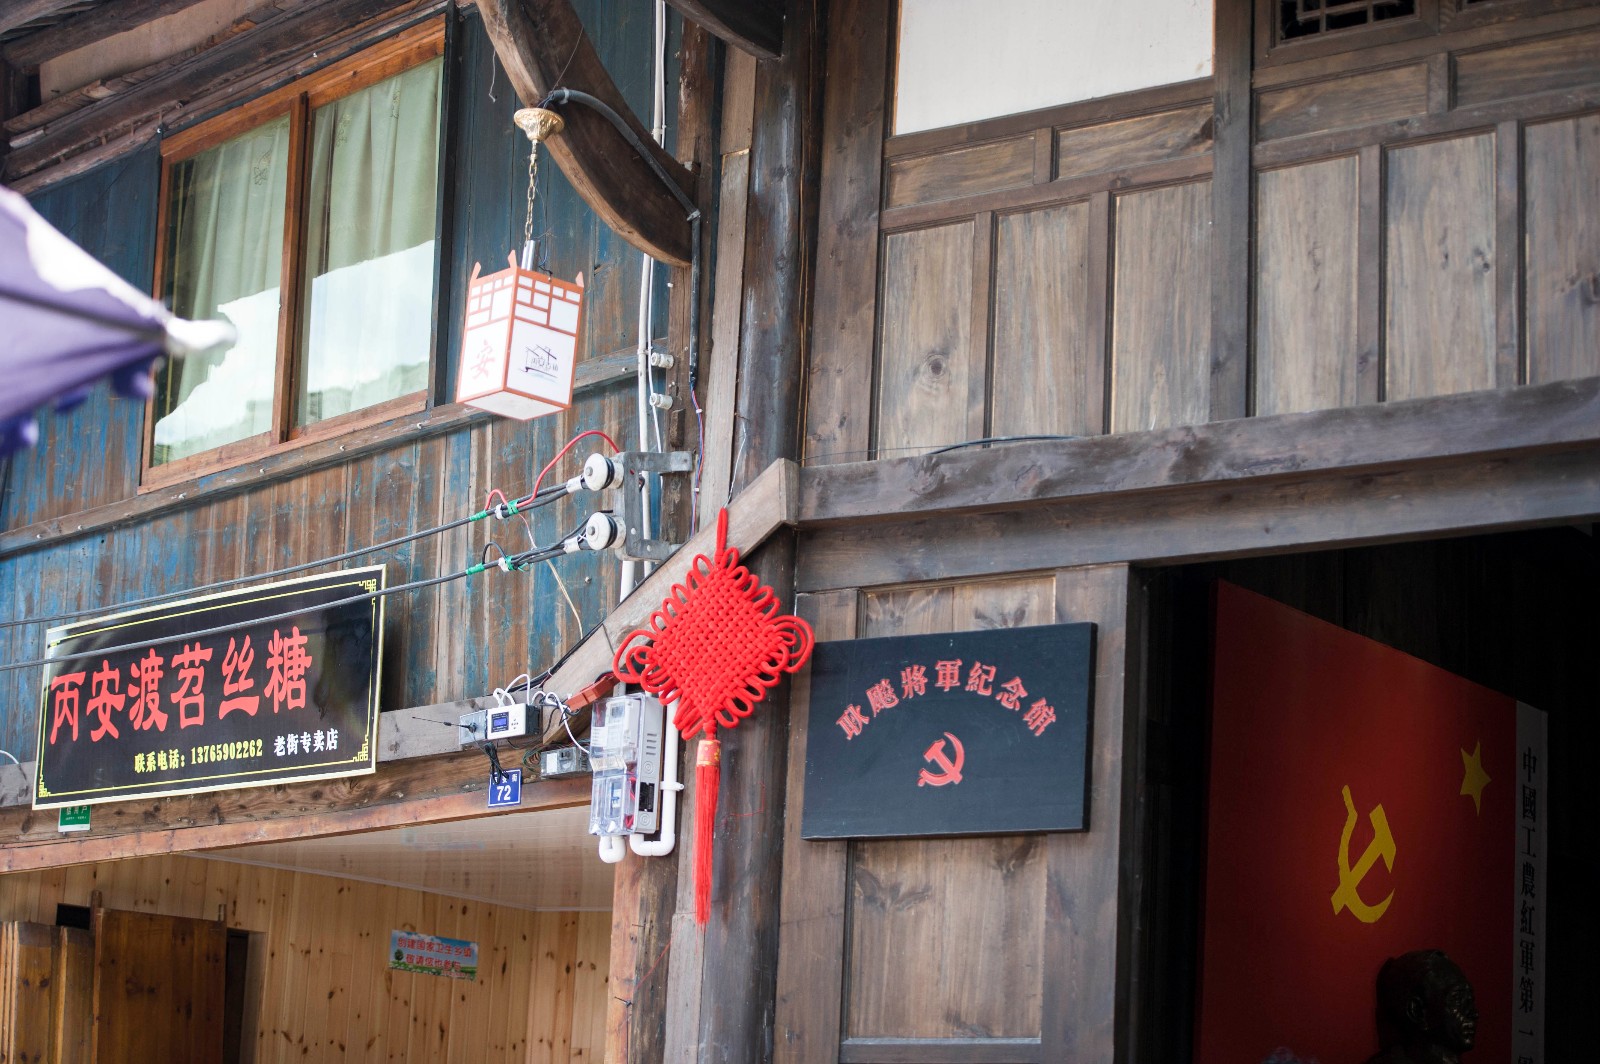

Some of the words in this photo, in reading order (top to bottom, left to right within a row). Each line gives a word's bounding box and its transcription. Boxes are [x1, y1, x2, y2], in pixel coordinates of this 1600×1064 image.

[470, 339, 496, 380] 安
[50, 626, 313, 745] 丙安渡苕丝糖
[191, 738, 263, 766] 13765902262
[273, 728, 339, 757] 老街专卖店
[496, 784, 512, 802] 72
[1517, 746, 1537, 1064] 中國工農紅軍第一
